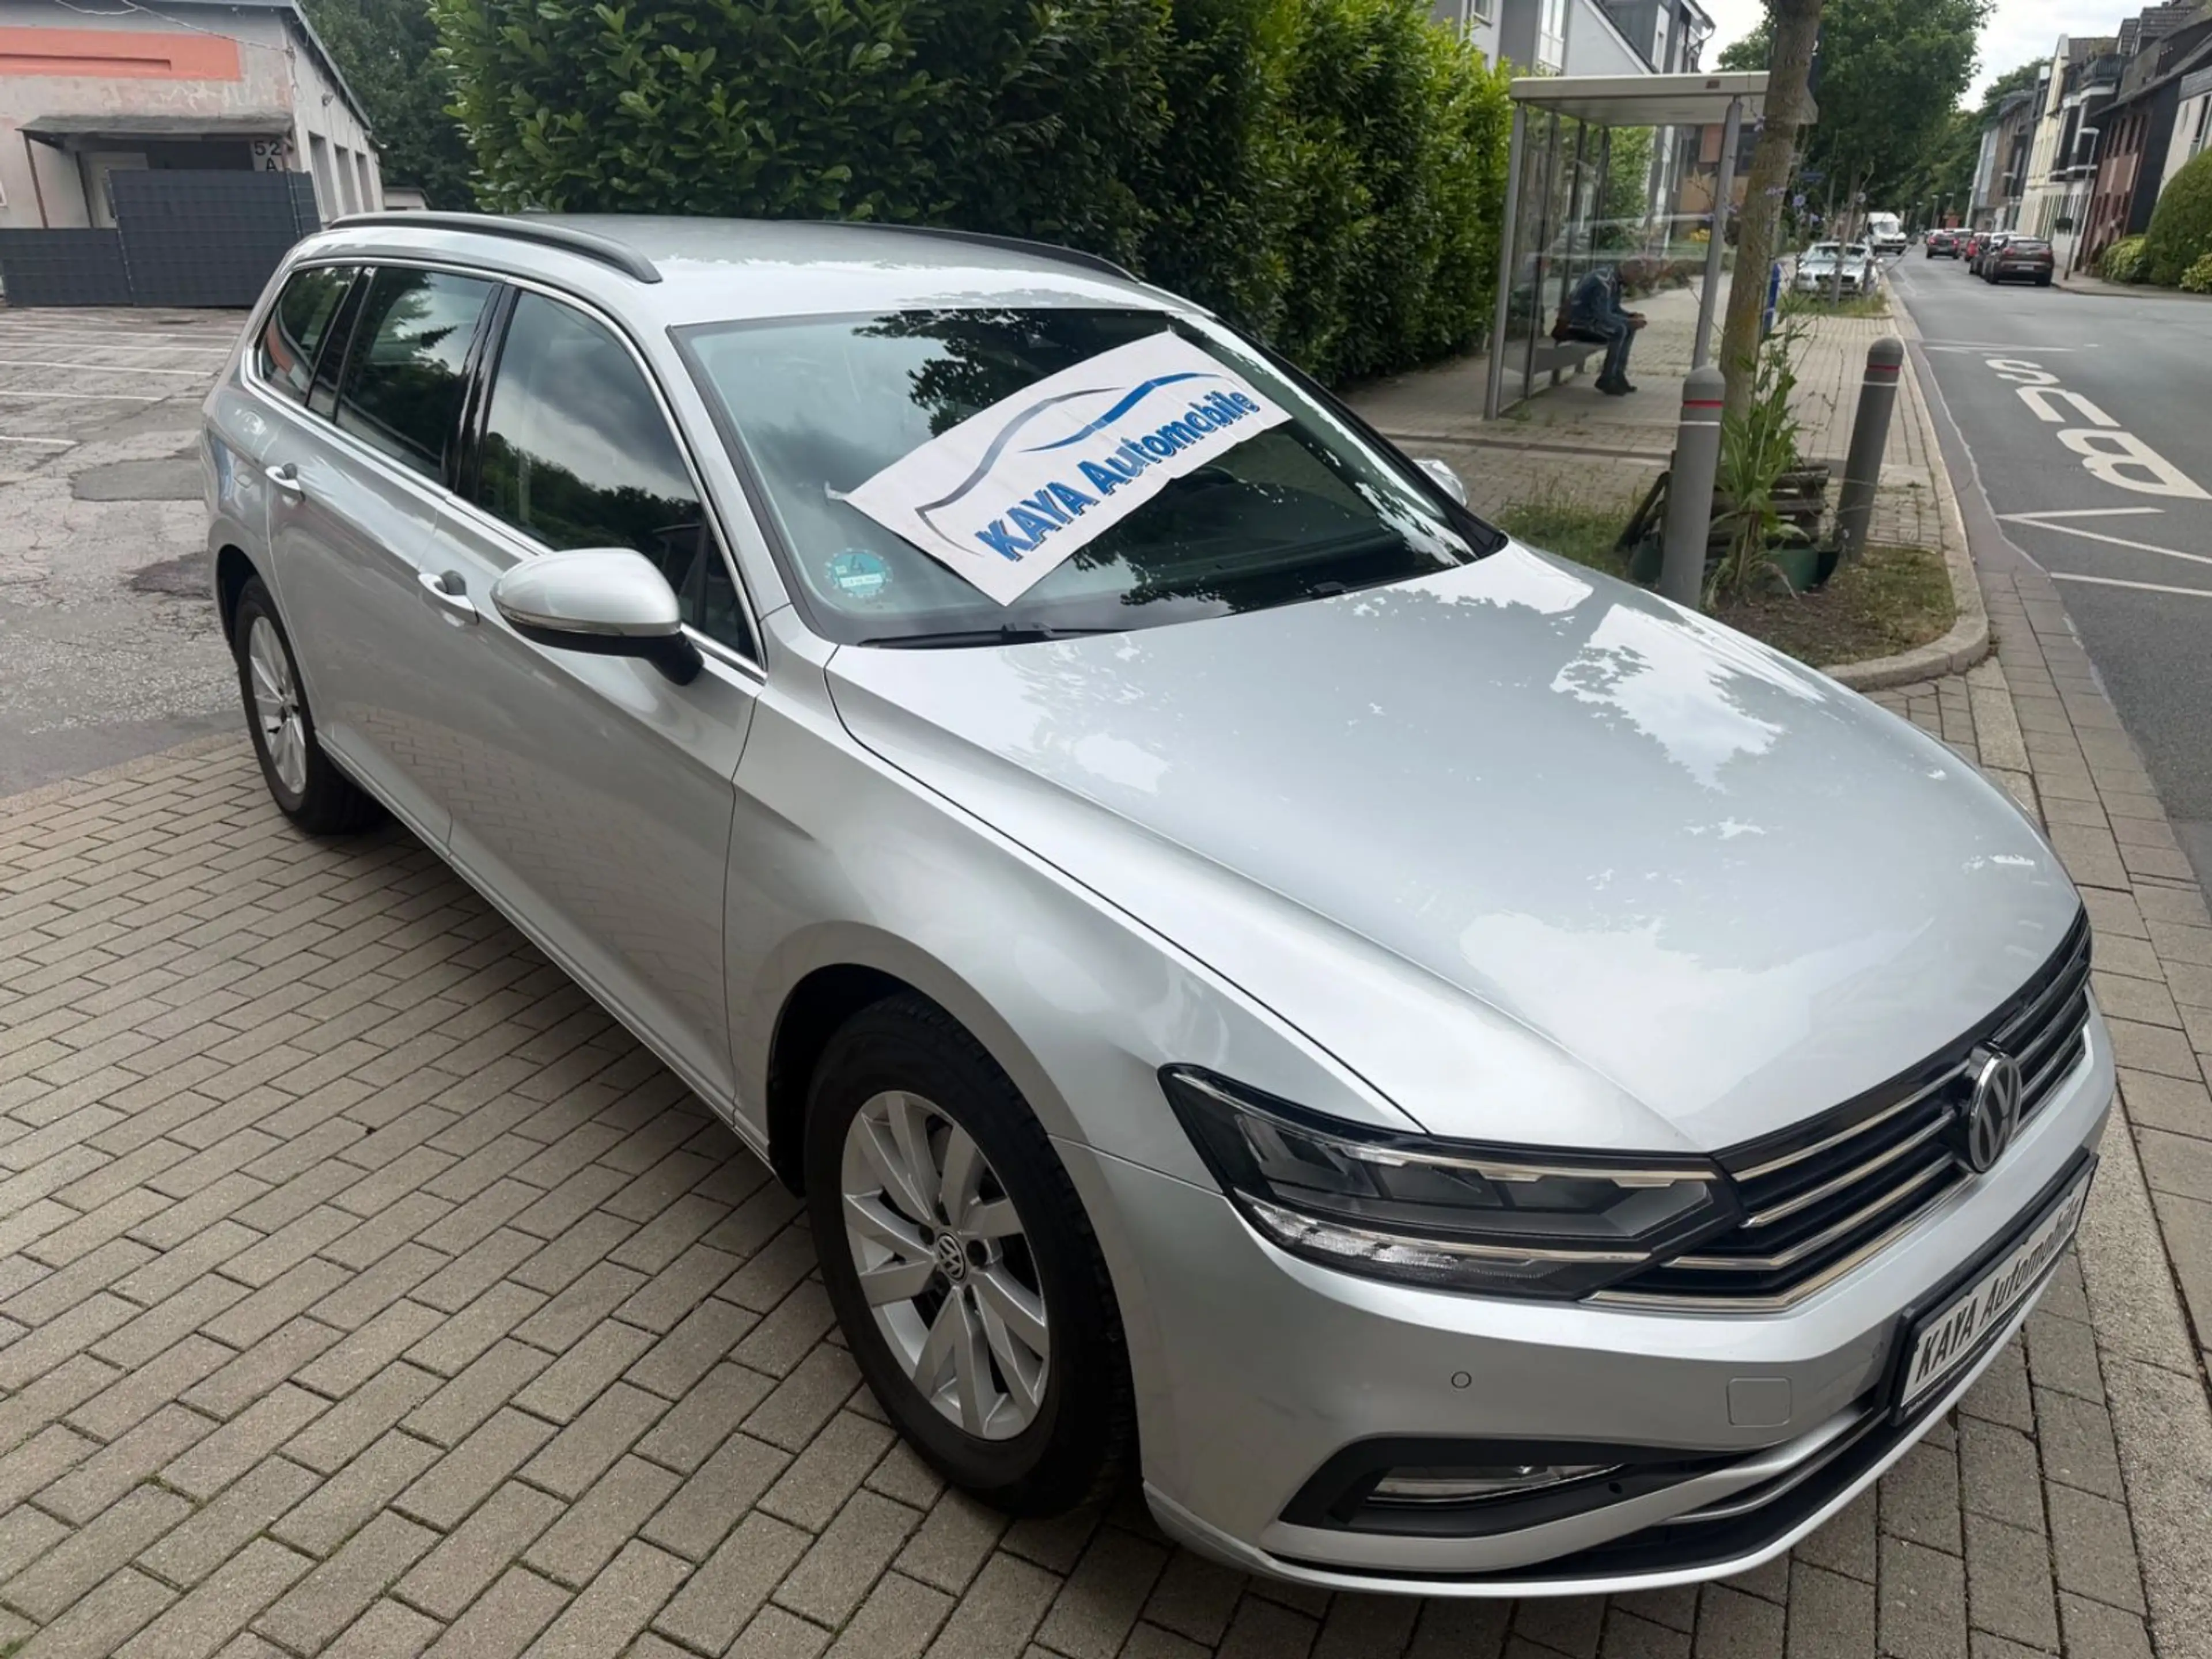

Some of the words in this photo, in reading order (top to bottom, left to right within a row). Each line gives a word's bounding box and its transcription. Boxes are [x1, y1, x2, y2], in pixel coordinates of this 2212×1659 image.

[254, 140, 282, 156] 52
[266, 157, 278, 173] A
[1985, 359, 2212, 500] BUS
[975, 482, 1100, 562] KAYA
[1077, 390, 1260, 496] Automobile
[1916, 1296, 1978, 1384] KAYA
